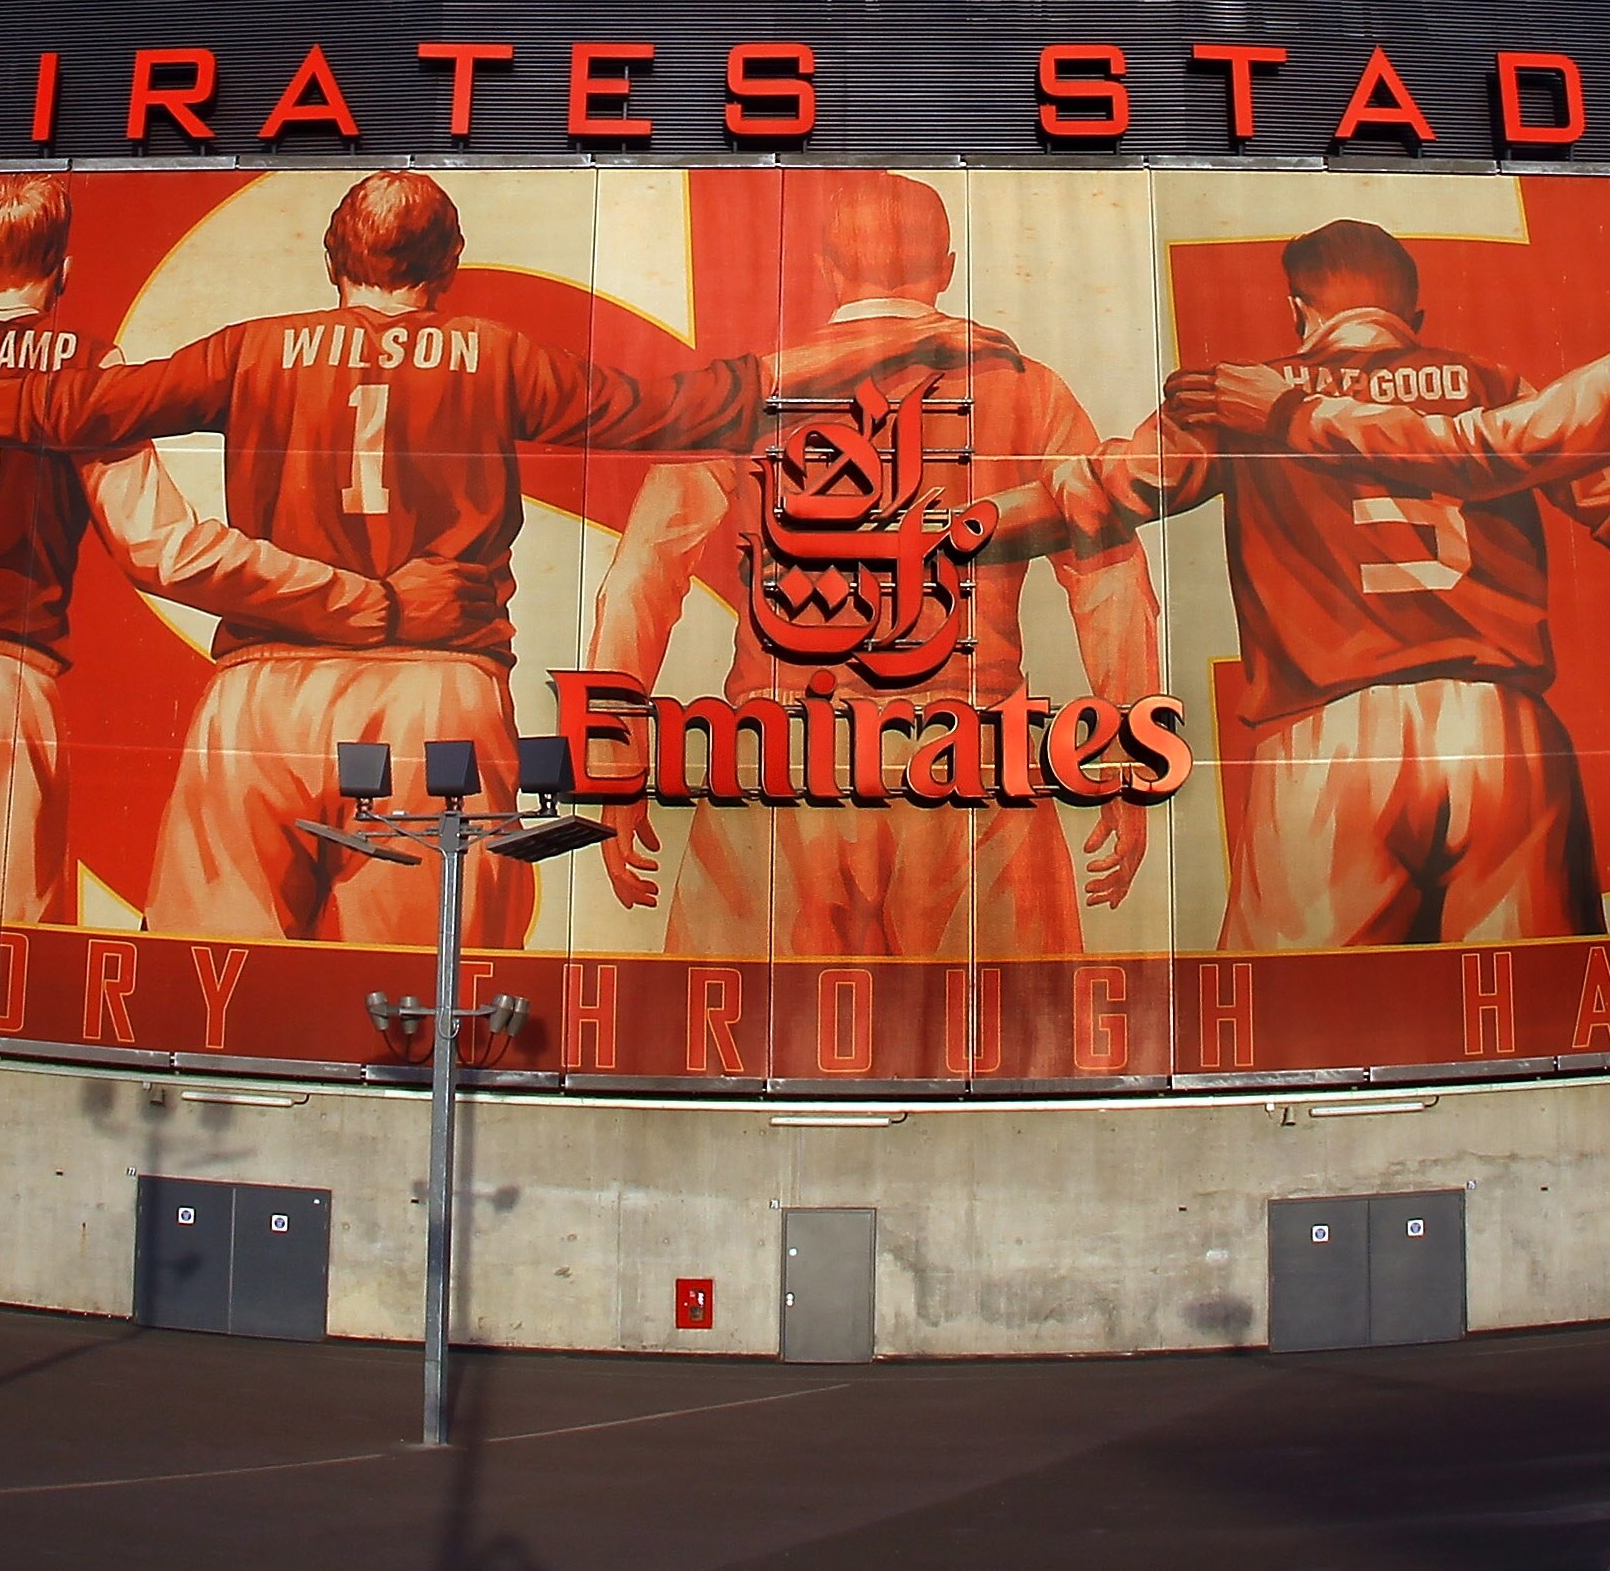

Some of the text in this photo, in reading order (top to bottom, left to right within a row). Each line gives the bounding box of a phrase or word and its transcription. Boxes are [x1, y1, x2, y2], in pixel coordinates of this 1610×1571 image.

[281, 321, 482, 375] WILSON
[341, 383, 393, 516] 1
[547, 669, 1195, 809] Emirates
